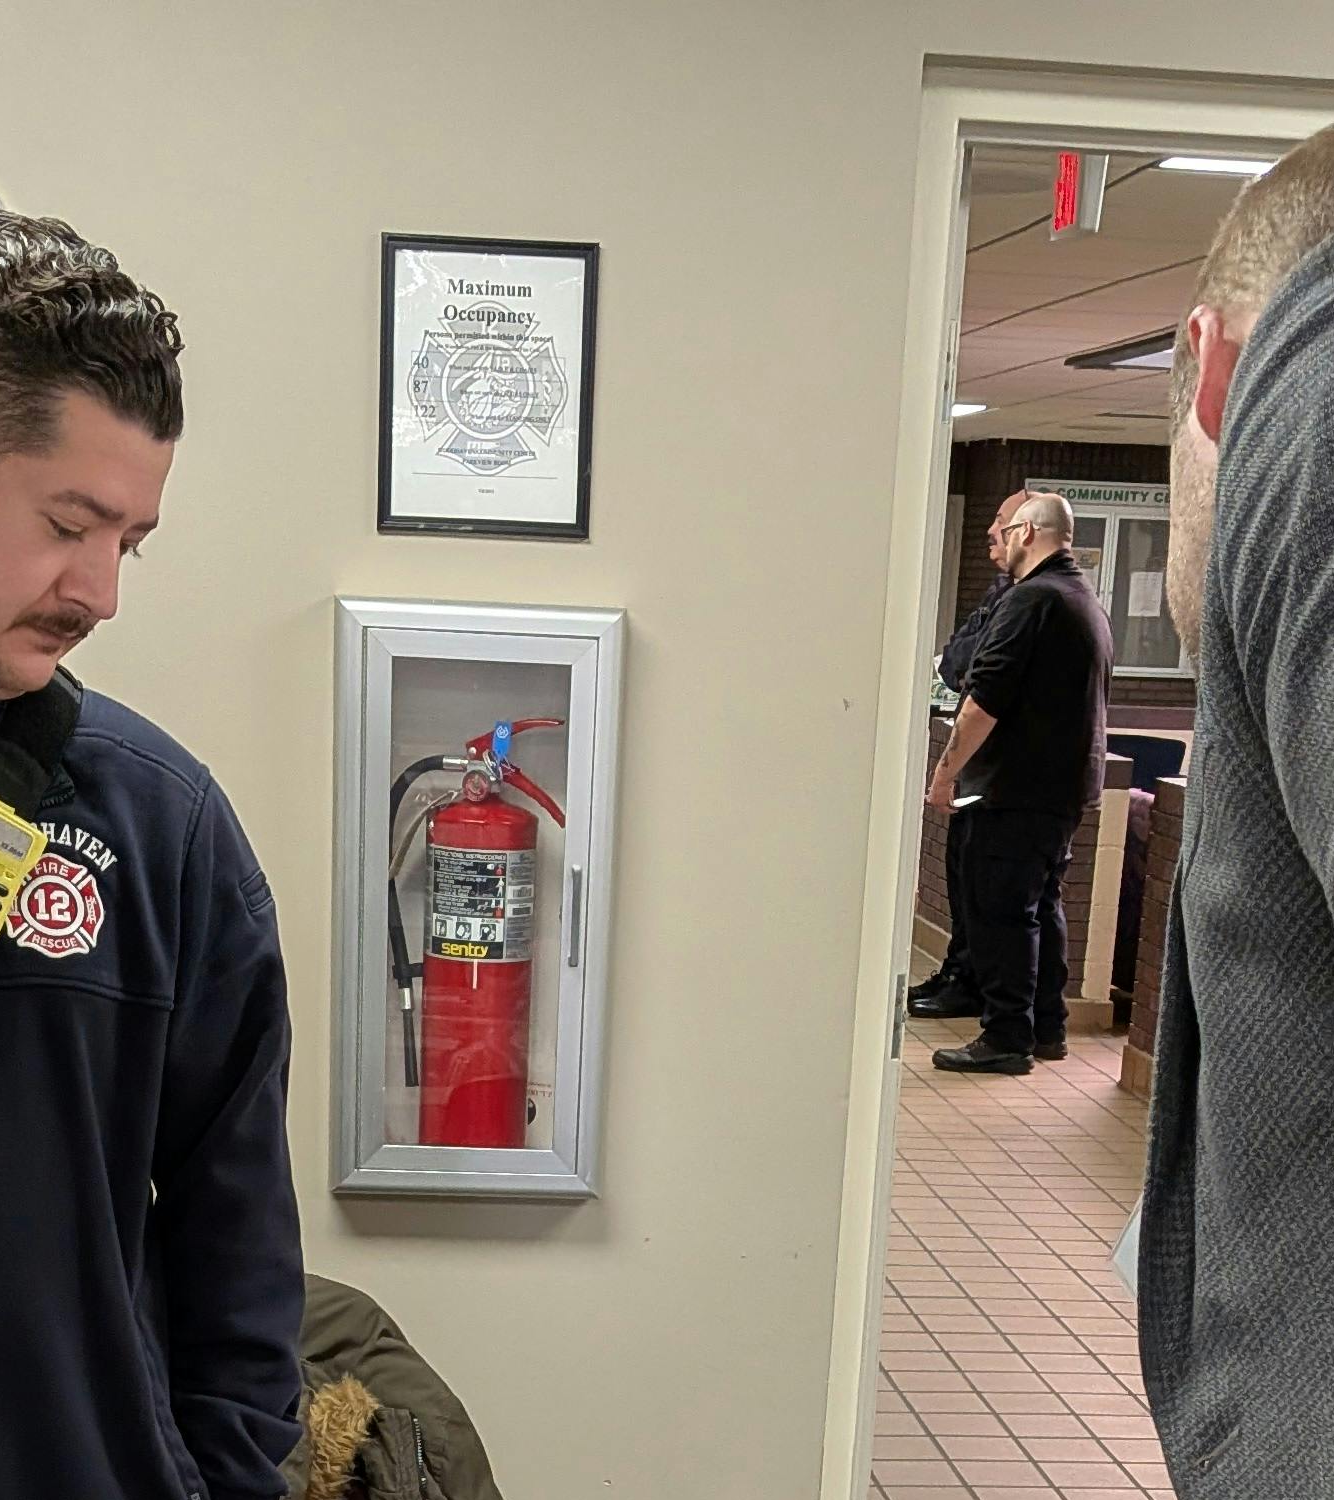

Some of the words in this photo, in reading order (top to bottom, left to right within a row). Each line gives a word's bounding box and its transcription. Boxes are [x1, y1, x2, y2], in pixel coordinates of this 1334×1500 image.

[447, 278, 532, 298] Maximum
[443, 304, 536, 329] Occupancy
[455, 333, 490, 342] permitted
[412, 356, 429, 369] 40
[413, 380, 429, 394] 87
[414, 404, 436, 418] 122
[1058, 487, 1149, 502] COMMUNITY
[34, 861, 69, 878] FIRE
[33, 888, 72, 922] 12
[31, 934, 78, 949] RESCUE
[440, 941, 489, 958] sentry
